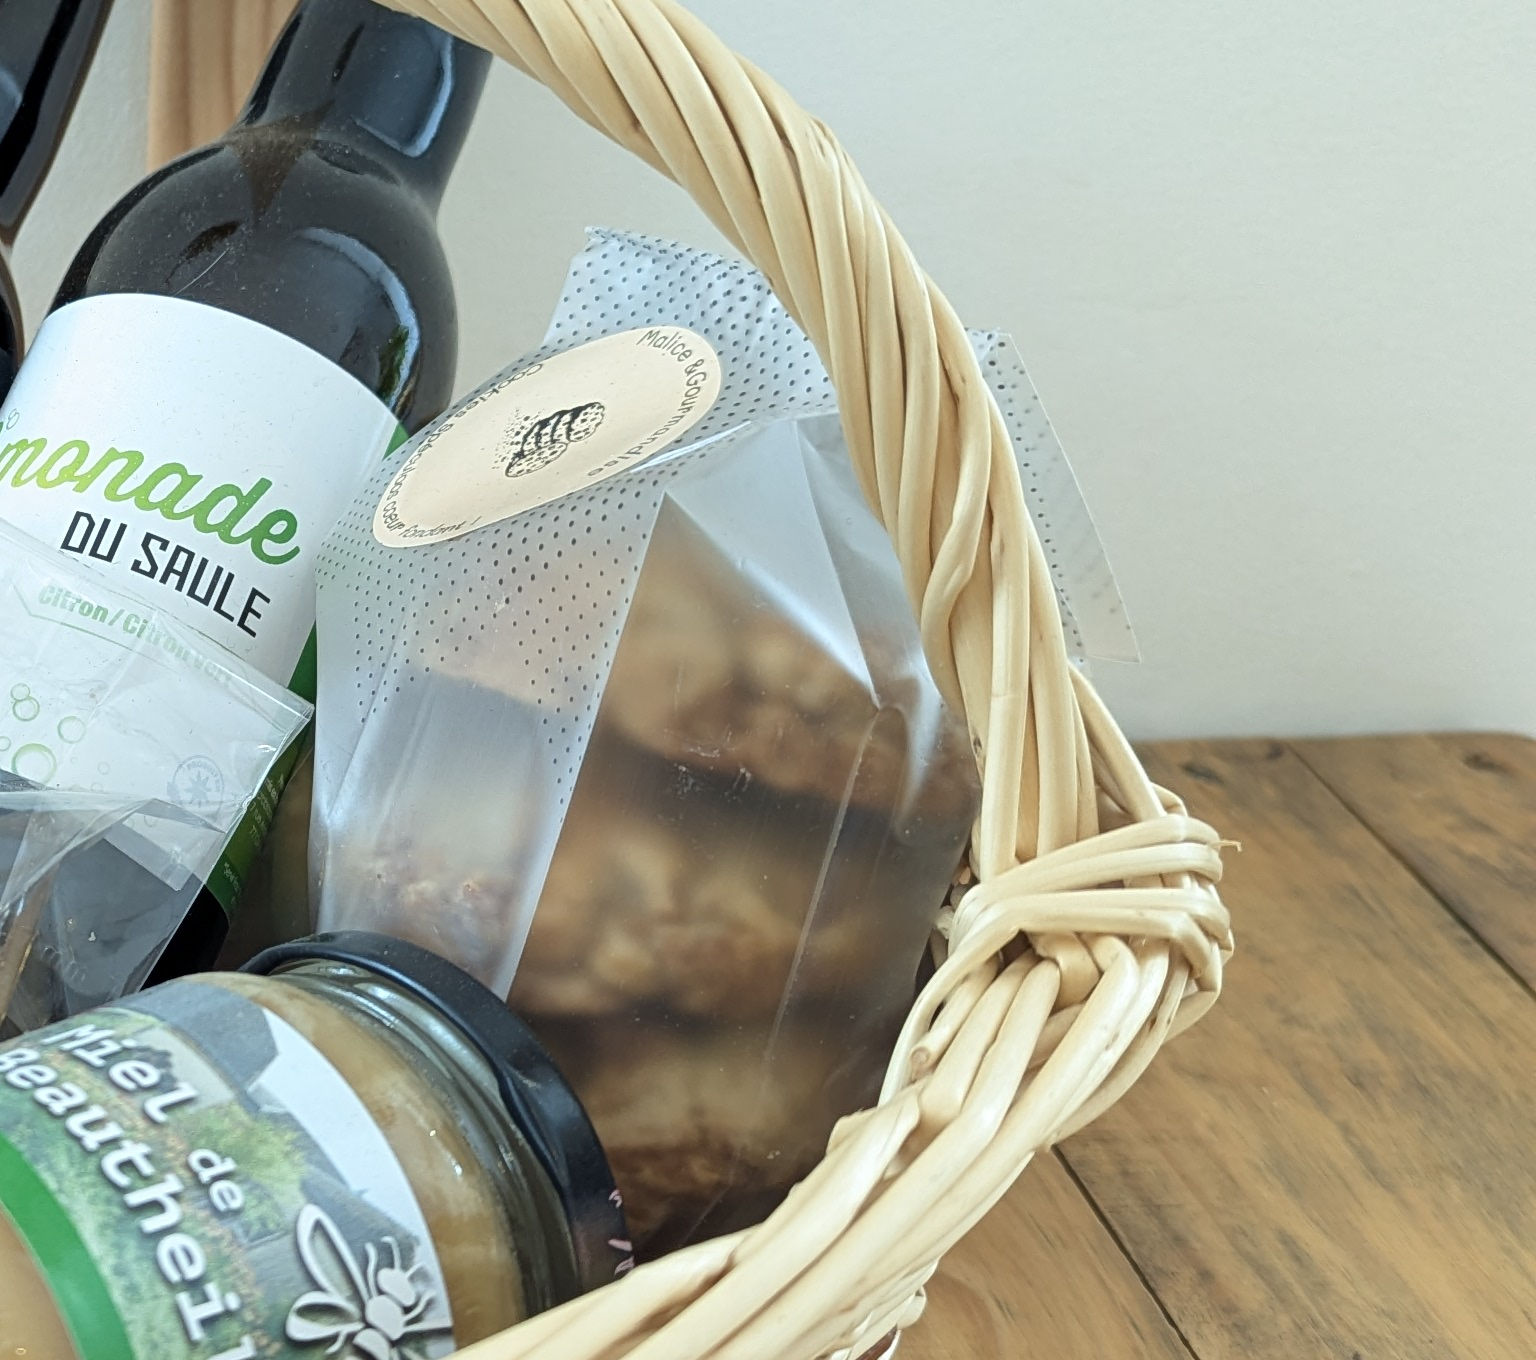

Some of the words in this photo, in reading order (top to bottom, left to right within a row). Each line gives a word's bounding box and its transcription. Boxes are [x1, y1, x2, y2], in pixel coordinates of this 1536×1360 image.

[636, 329, 694, 362] Malice
[60, 510, 128, 564] DU
[130, 531, 272, 639] SAULE
[41, 1022, 199, 1124] Miel
[185, 1147, 245, 1213] de
